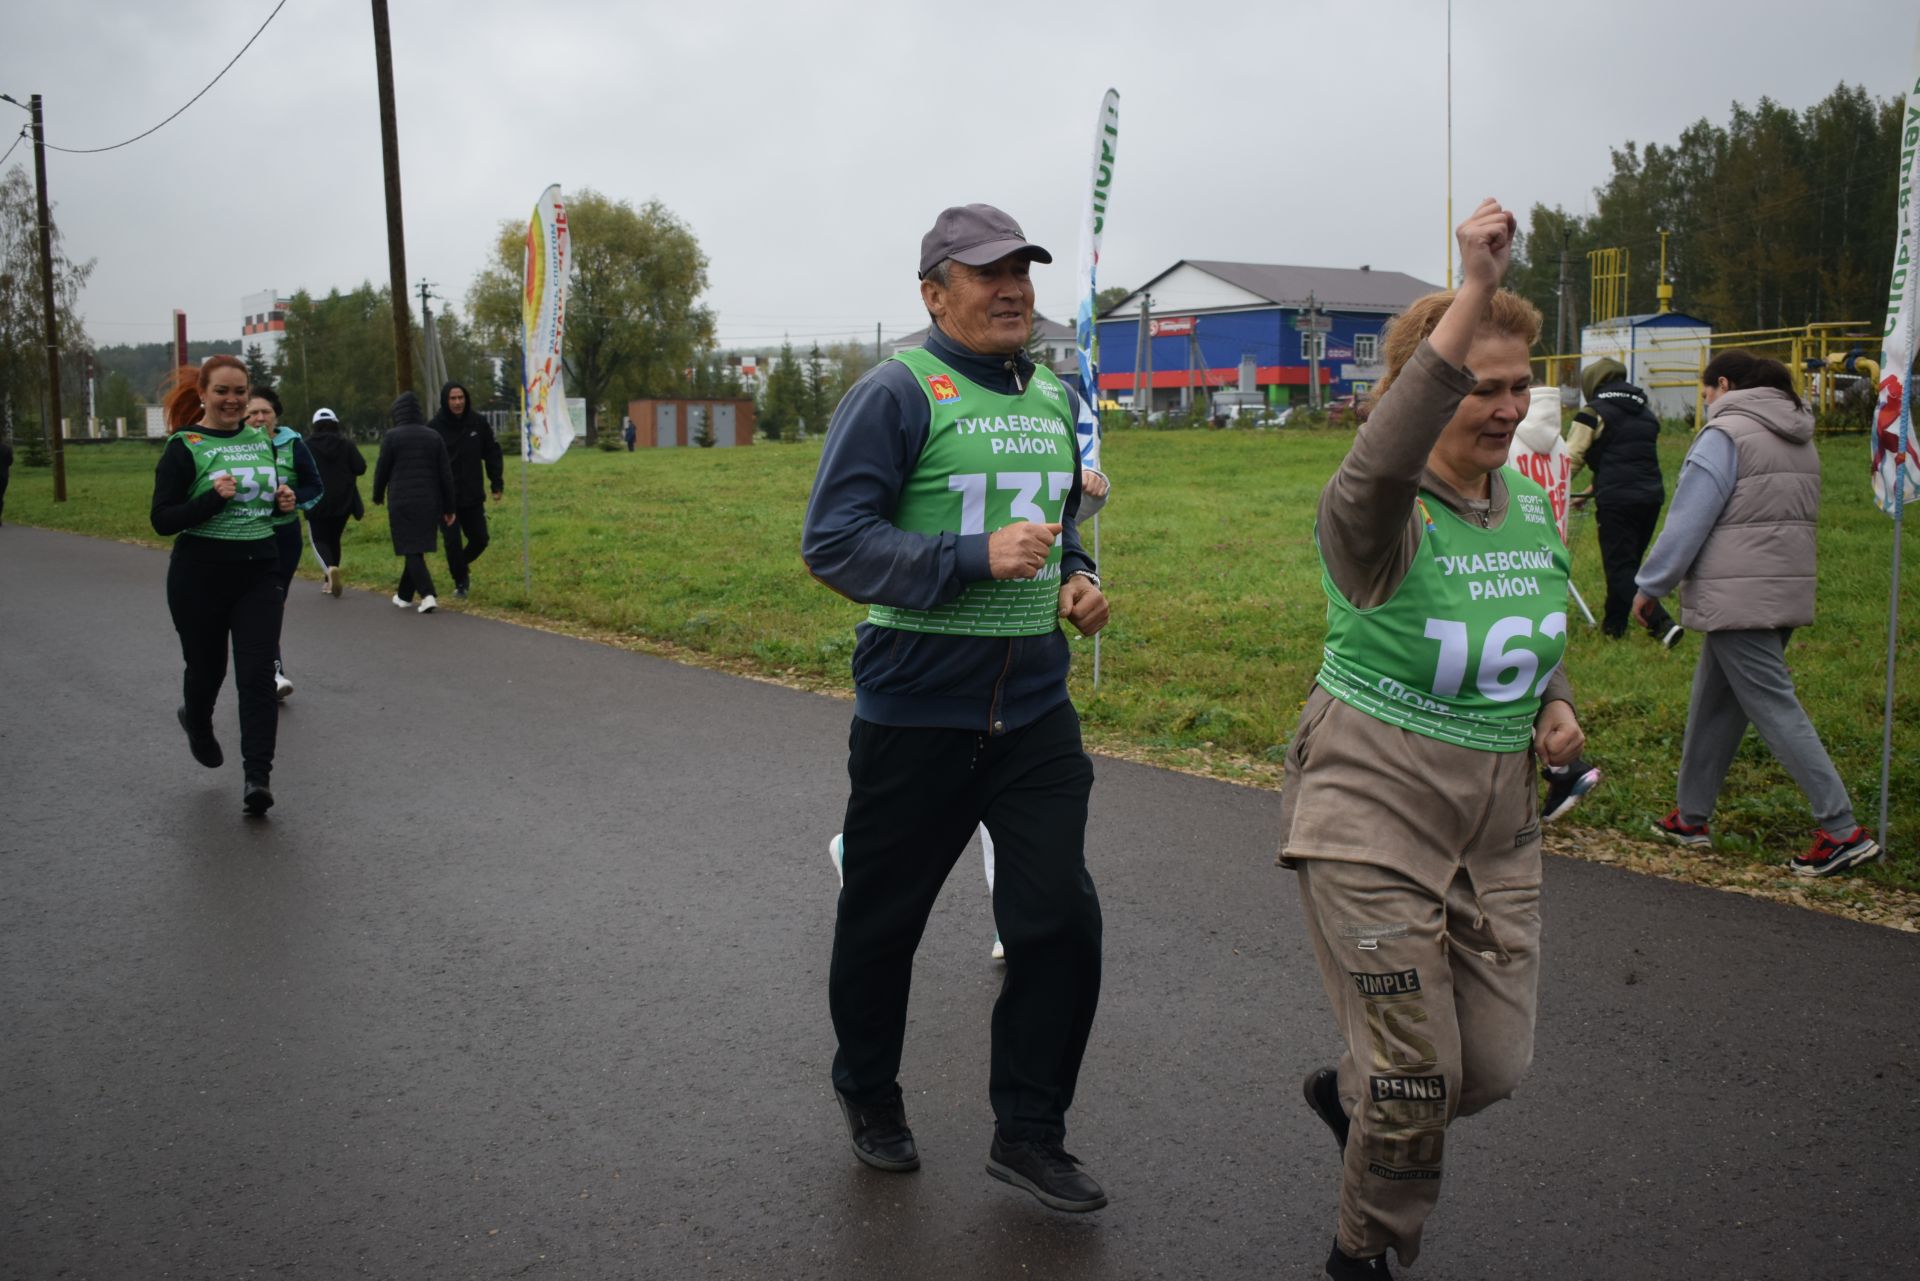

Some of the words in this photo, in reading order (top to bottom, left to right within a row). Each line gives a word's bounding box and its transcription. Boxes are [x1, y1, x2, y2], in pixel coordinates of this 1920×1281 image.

[955, 414, 1067, 437] ТУКАЕВСКИЙ
[990, 433, 1058, 455] РАЙОН
[1468, 573, 1541, 601] РАЙОН
[1352, 970, 1417, 993] SIMPLE
[1364, 1001, 1438, 1074] IS
[1376, 1078, 1442, 1099] BEING
